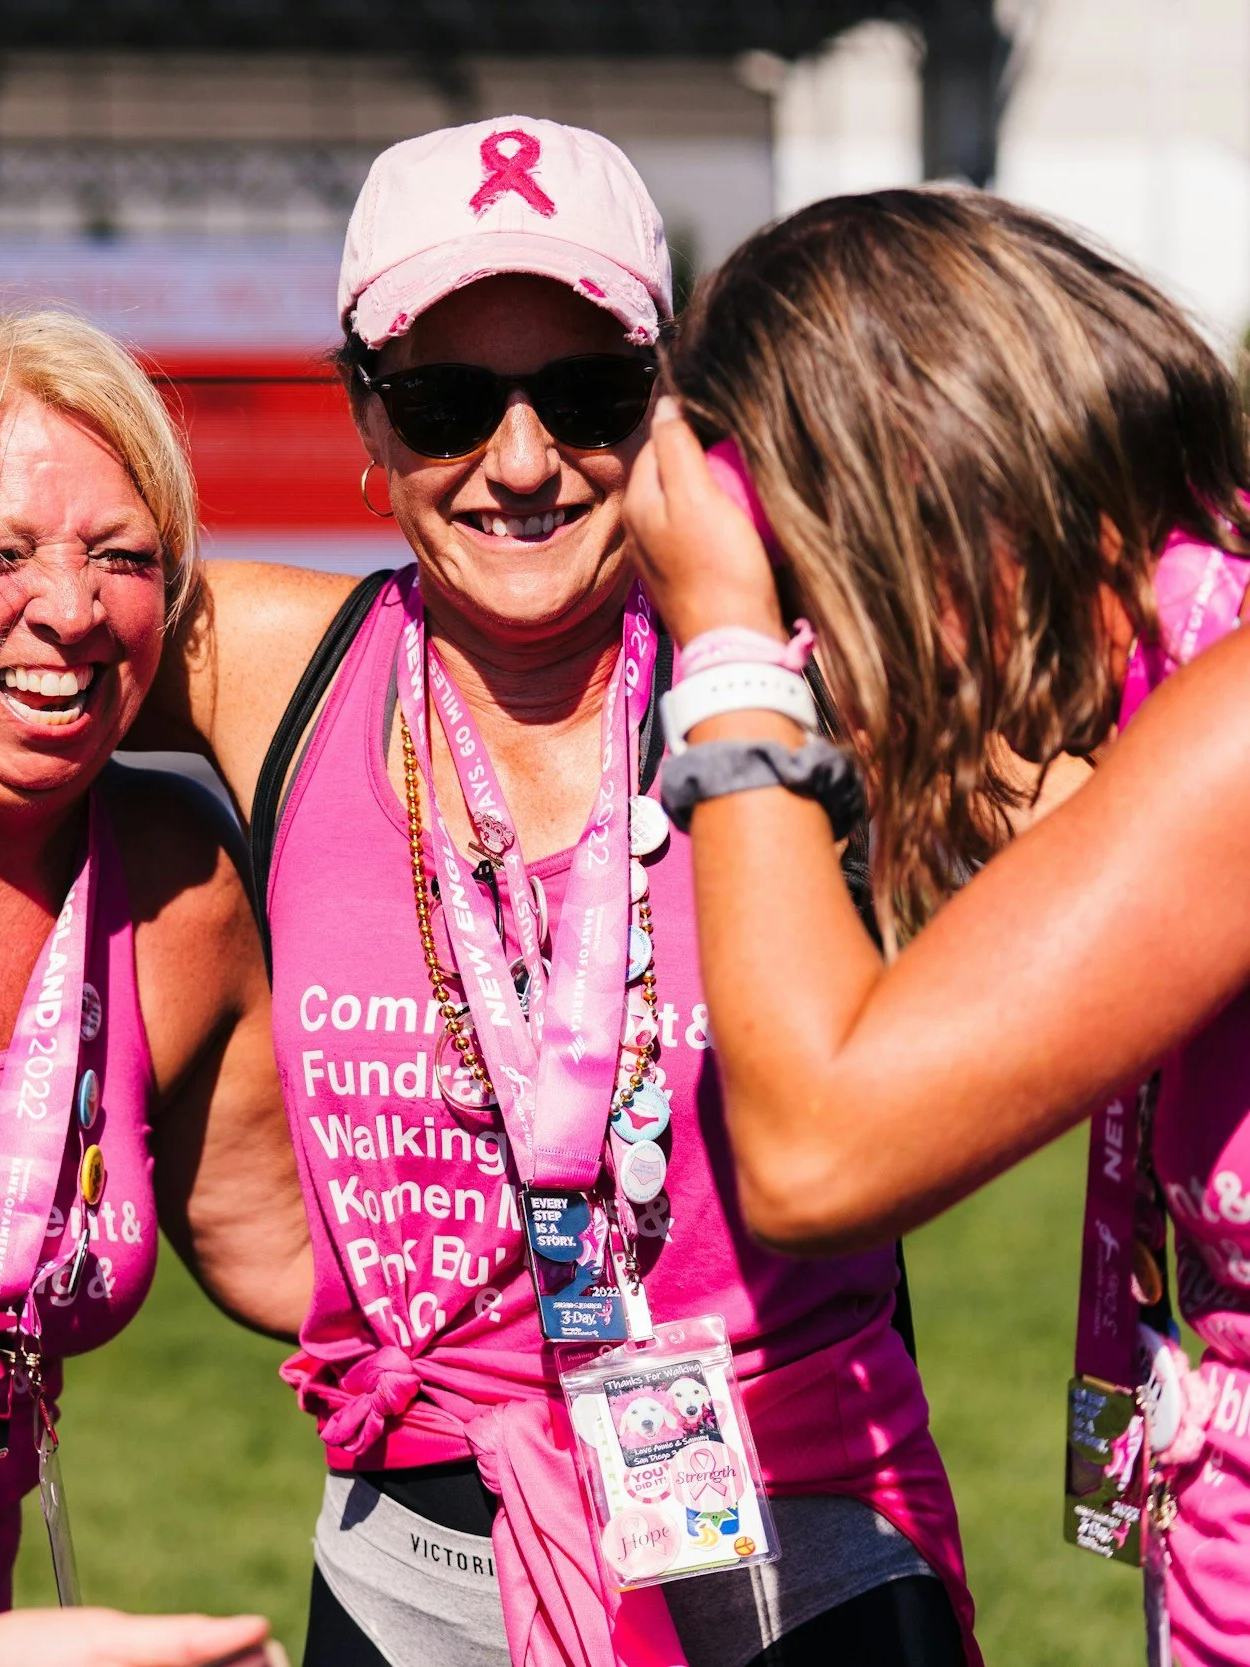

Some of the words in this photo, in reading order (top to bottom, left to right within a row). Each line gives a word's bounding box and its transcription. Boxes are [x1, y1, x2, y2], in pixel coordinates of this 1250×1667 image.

[455, 725, 476, 758] 60
[588, 780, 615, 867] 2022
[580, 908, 594, 946] BANK
[34, 890, 76, 1028] GLAND
[579, 949, 590, 967] OF
[467, 940, 513, 1028] NEW
[571, 969, 586, 1033] AMERICA
[17, 1038, 57, 1120] 2022
[309, 1114, 507, 1177] Walking
[5, 1157, 22, 1195] BANK
[2, 1198, 15, 1217] OF
[328, 1176, 485, 1224] Komen
[531, 1197, 568, 1209] EVERY
[533, 1210, 562, 1222] STEP
[535, 1223, 547, 1234] IS
[548, 1223, 559, 1234] A
[537, 1235, 576, 1247] STORY.
[592, 1286, 621, 1297] 2022
[605, 1378, 643, 1390] Thanks
[645, 1372, 661, 1383] For
[664, 1364, 702, 1379] Walking
[633, 1456, 649, 1466] San
[650, 1451, 672, 1462] Diego
[634, 1446, 653, 1455] Love
[631, 1467, 664, 1482] YOU
[635, 1480, 653, 1491] DID
[654, 1477, 668, 1489] IT!
[676, 1466, 737, 1485] Strength
[411, 1533, 494, 1577] VICTORI
[617, 1525, 671, 1561] Hope
